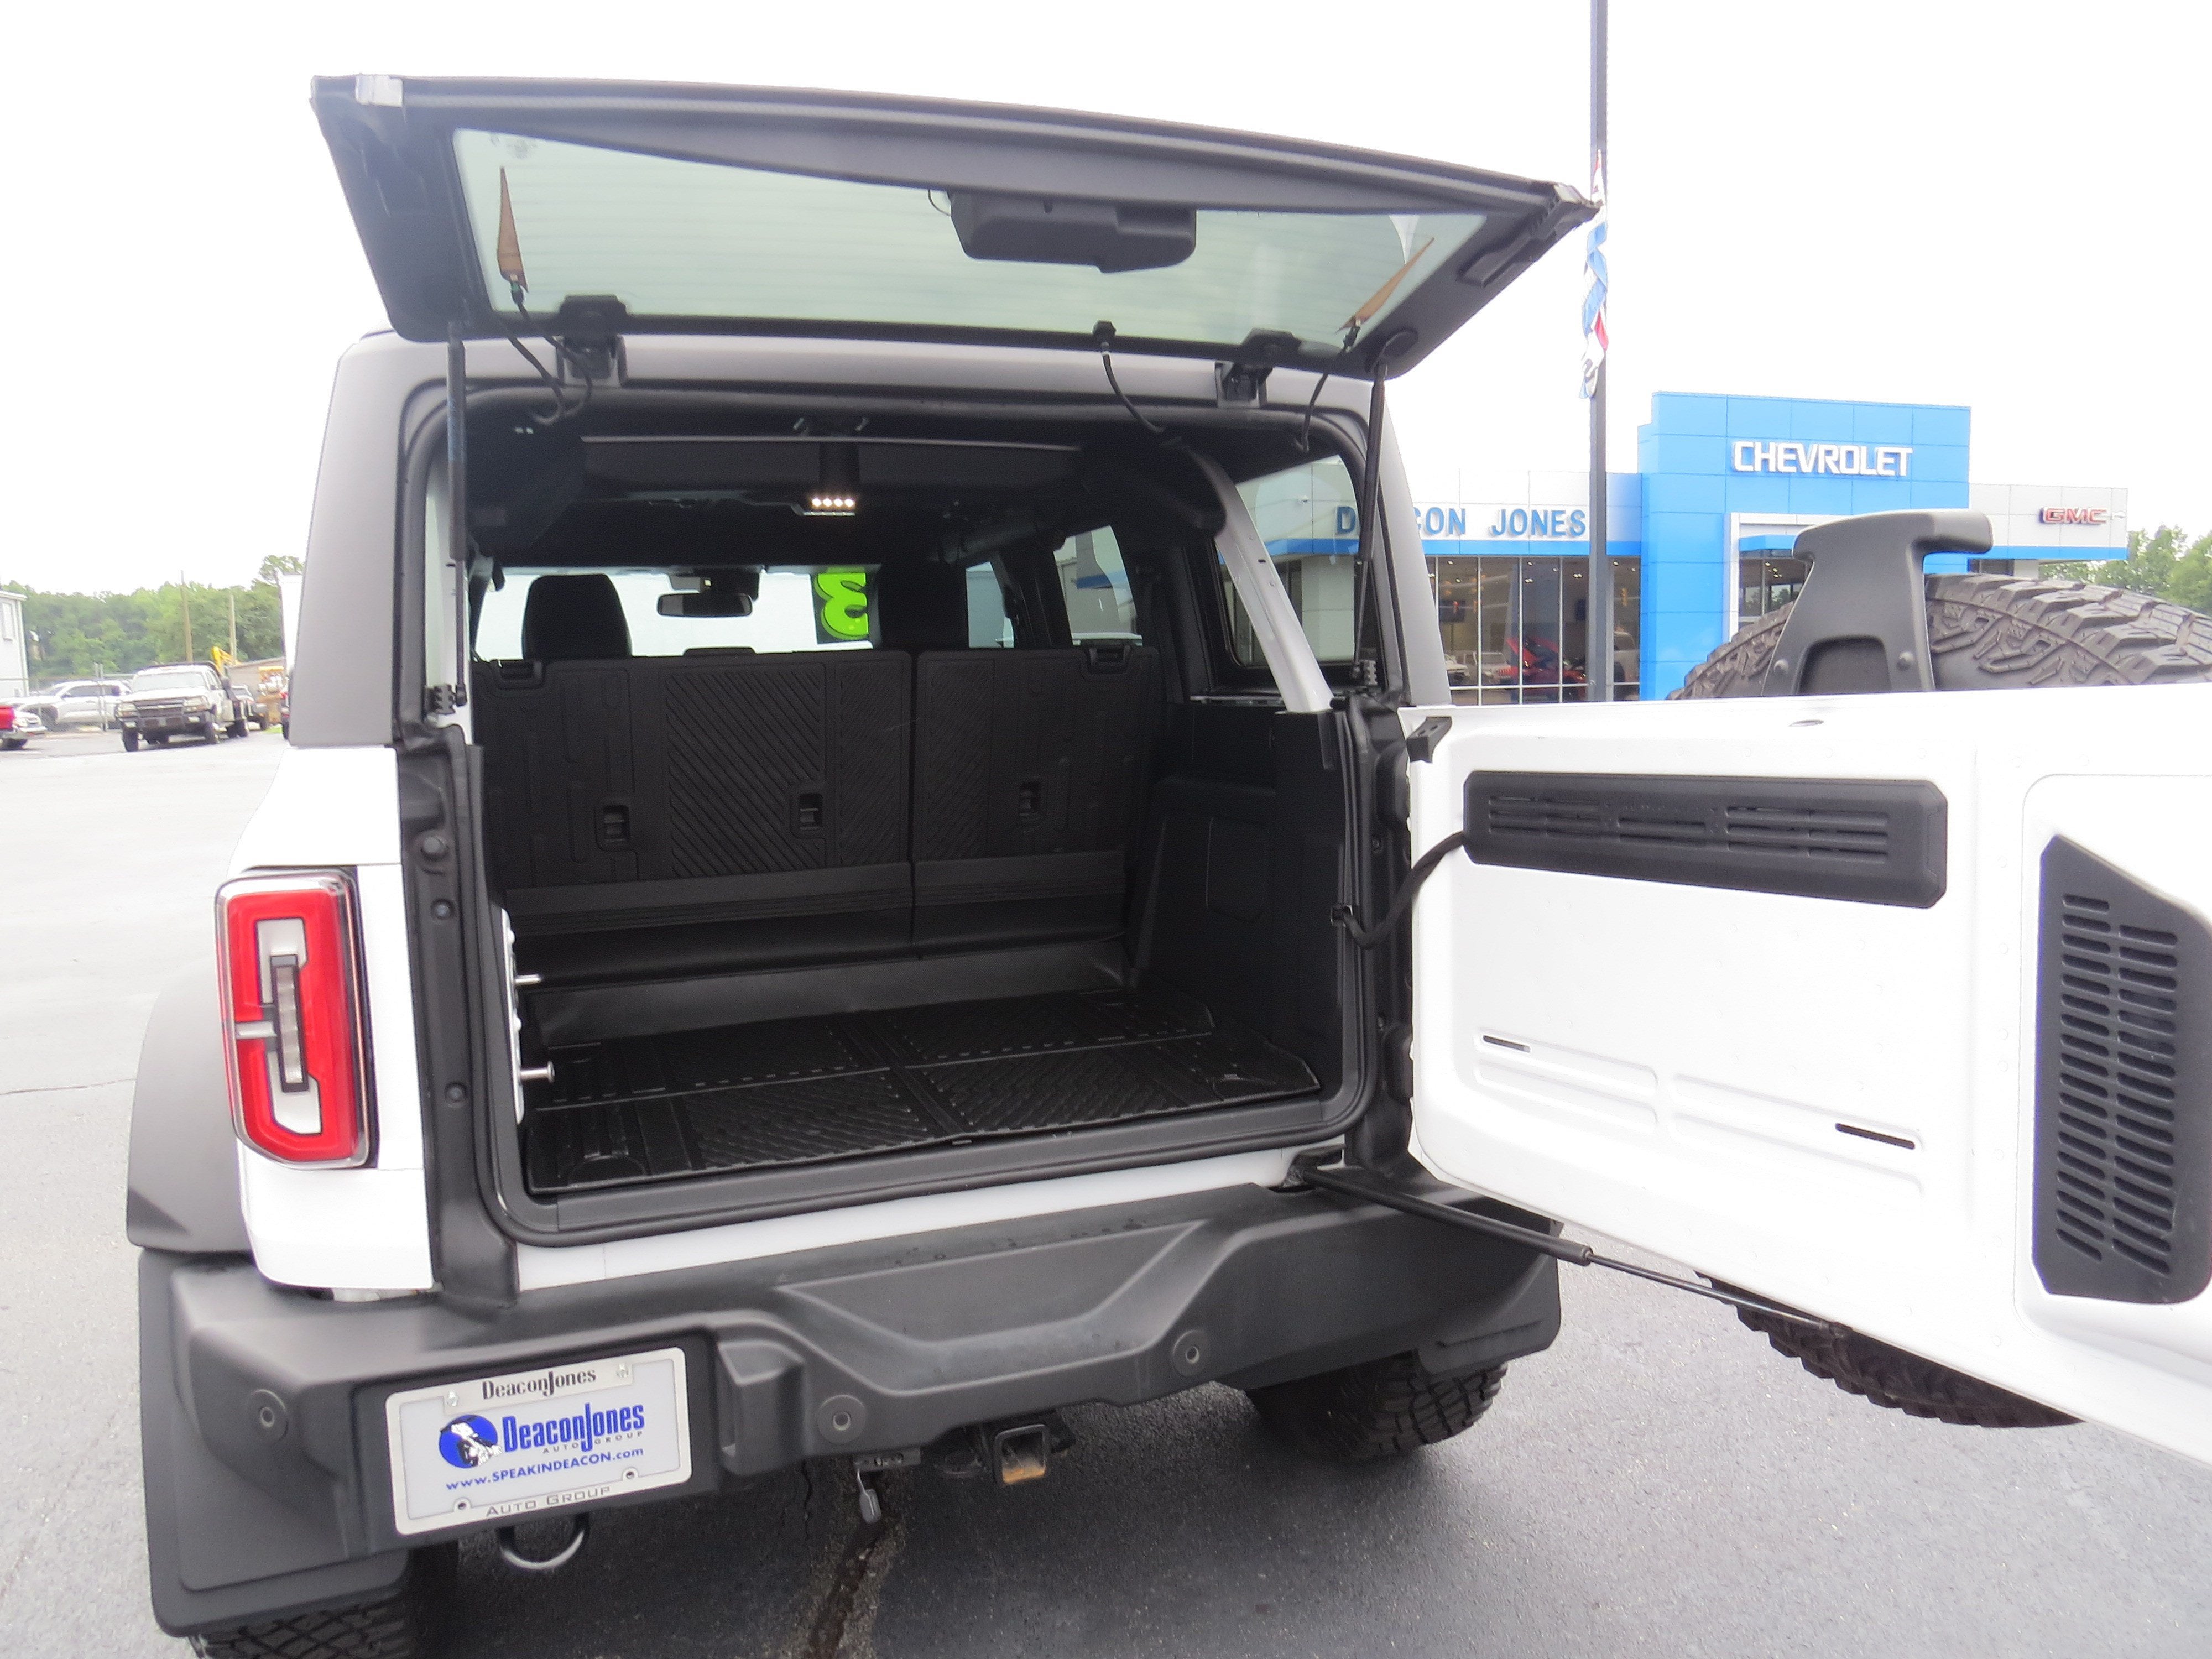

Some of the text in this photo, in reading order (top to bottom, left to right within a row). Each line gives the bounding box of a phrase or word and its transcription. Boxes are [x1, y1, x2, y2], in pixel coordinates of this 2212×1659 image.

[1734, 441, 1913, 476] CHEVROLET
[1491, 509, 1586, 536] JONES
[2044, 507, 2107, 525] GMC
[542, 1431, 643, 1453] AUTO GROUP
[446, 1447, 644, 1490] www.SPEAKINDEACON.com
